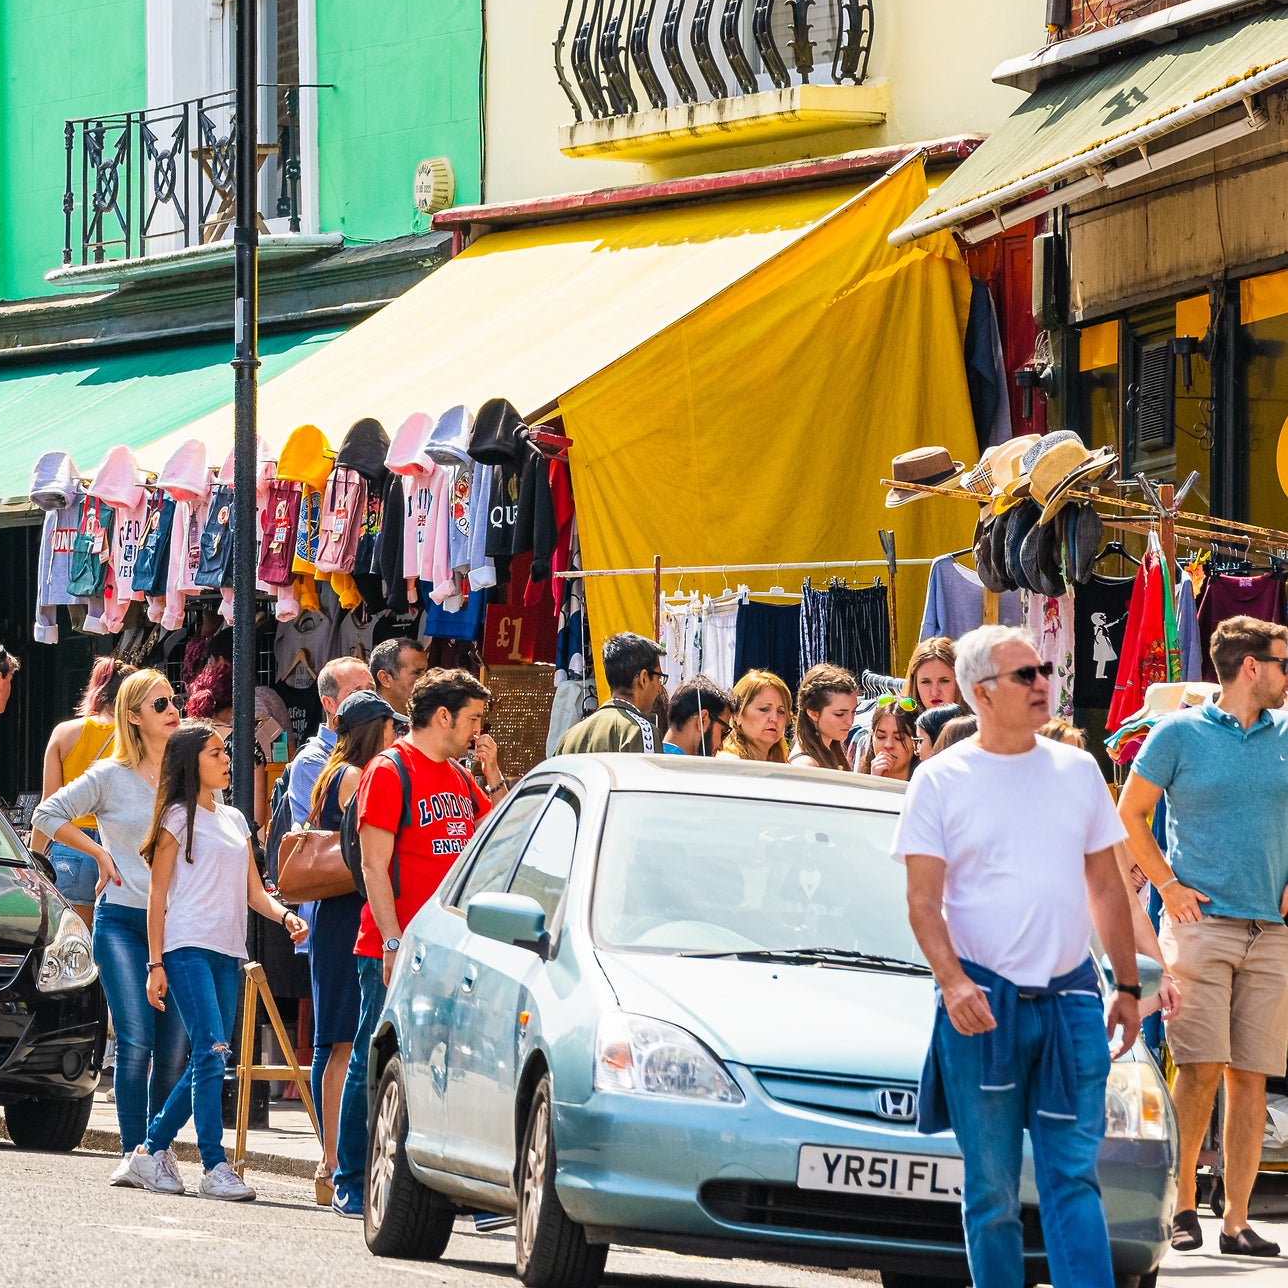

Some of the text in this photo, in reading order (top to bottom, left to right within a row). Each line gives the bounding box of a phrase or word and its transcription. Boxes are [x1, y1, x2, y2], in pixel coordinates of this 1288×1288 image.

[496, 616, 522, 660] £1
[432, 839, 470, 855] ENGL
[822, 1153, 898, 1188] YR51
